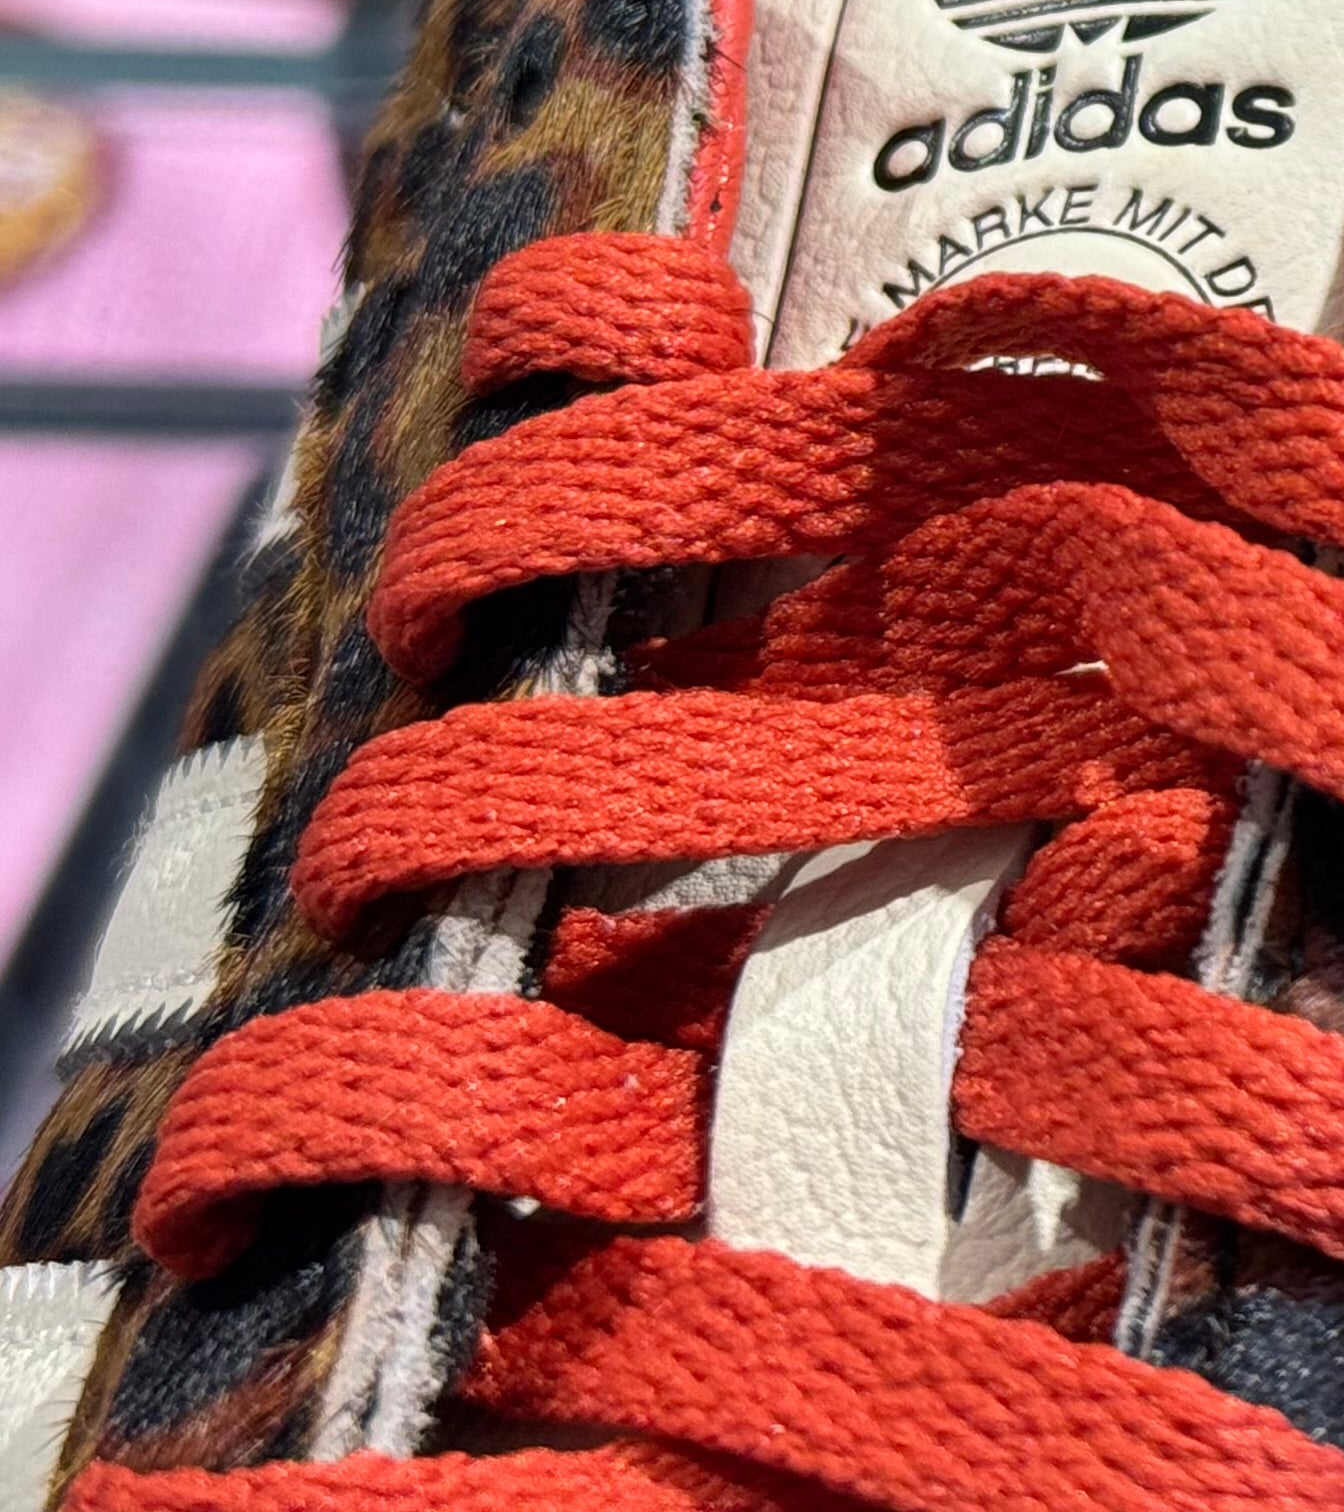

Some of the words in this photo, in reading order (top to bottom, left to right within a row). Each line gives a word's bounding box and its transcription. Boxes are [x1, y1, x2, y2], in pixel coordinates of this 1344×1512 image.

[873, 52, 1297, 192] adidas
[883, 182, 1099, 309] MARKE
[1112, 187, 1225, 255] MIT
